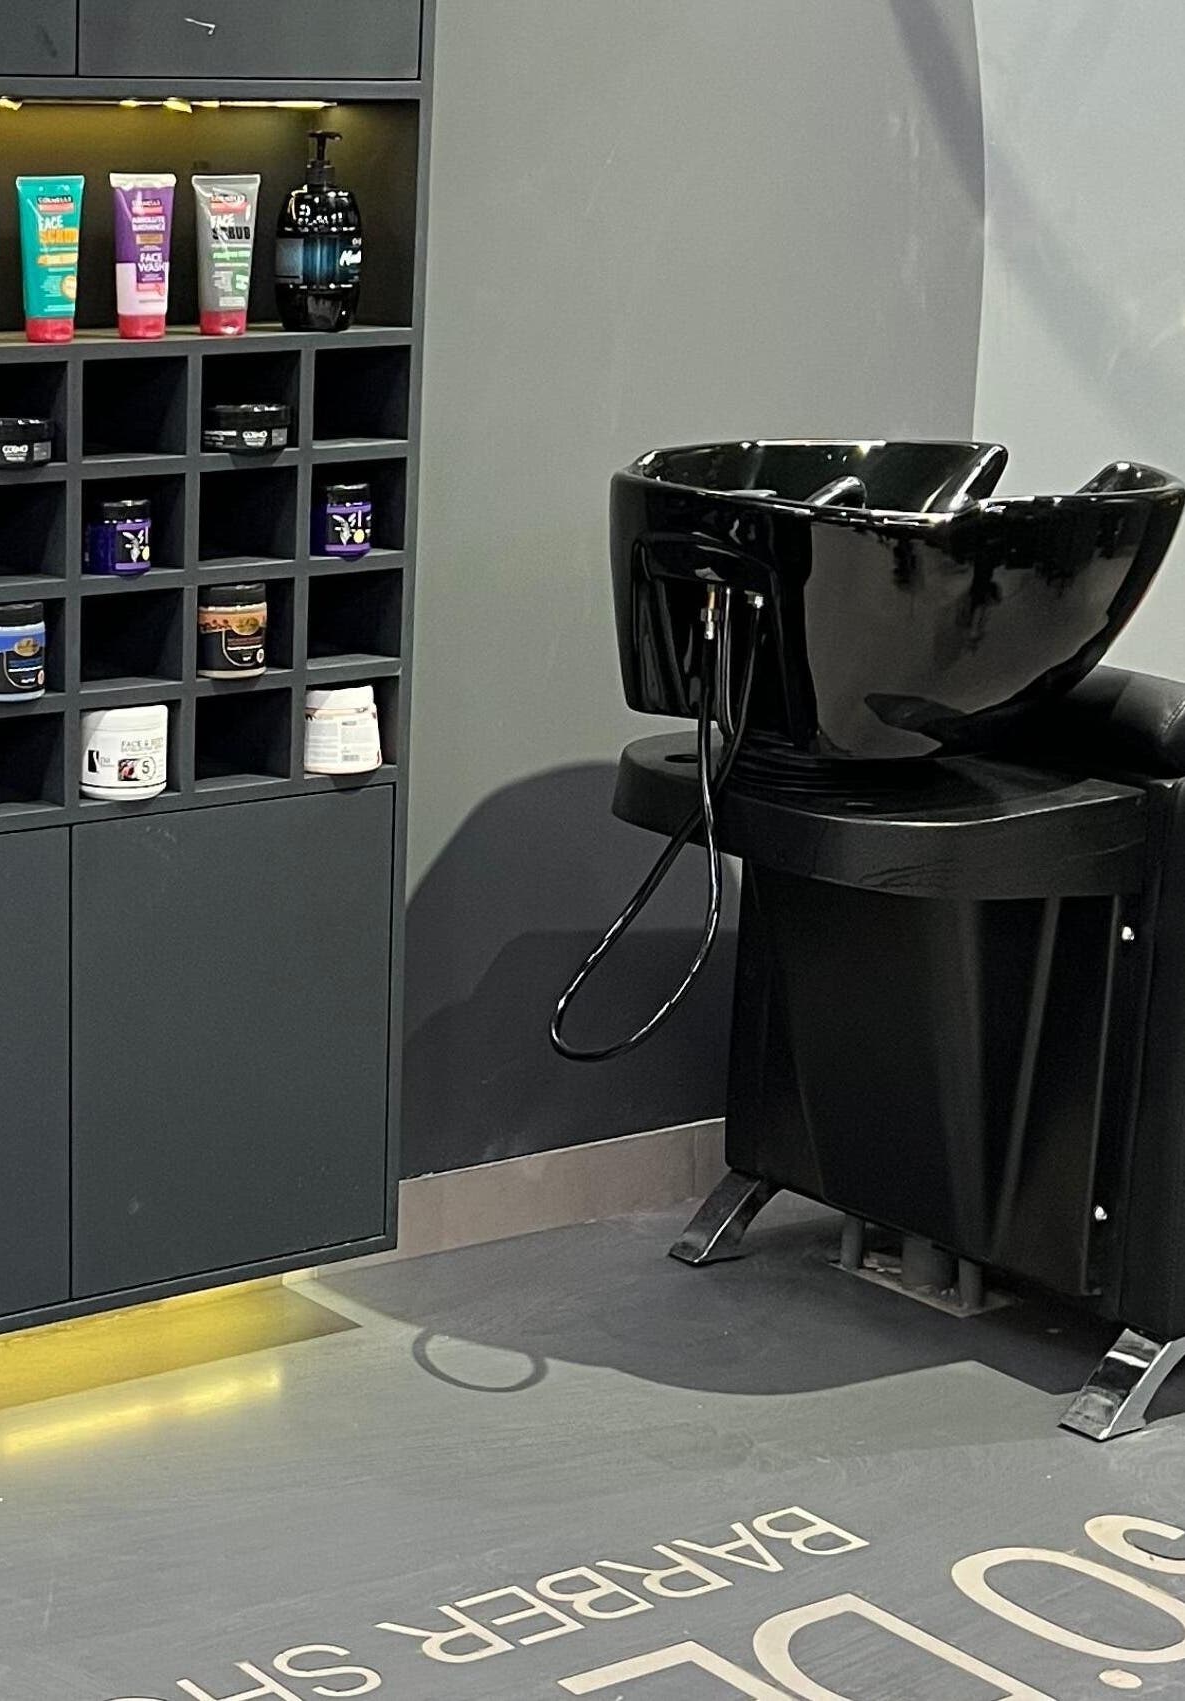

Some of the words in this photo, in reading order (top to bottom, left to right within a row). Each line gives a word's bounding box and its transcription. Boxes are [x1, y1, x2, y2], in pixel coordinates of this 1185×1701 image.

[38, 215, 64, 229] FACE
[209, 215, 236, 228] FACE
[139, 252, 163, 263] FACE
[137, 262, 166, 272] WASH
[373, 1505, 870, 1665] BARBER
